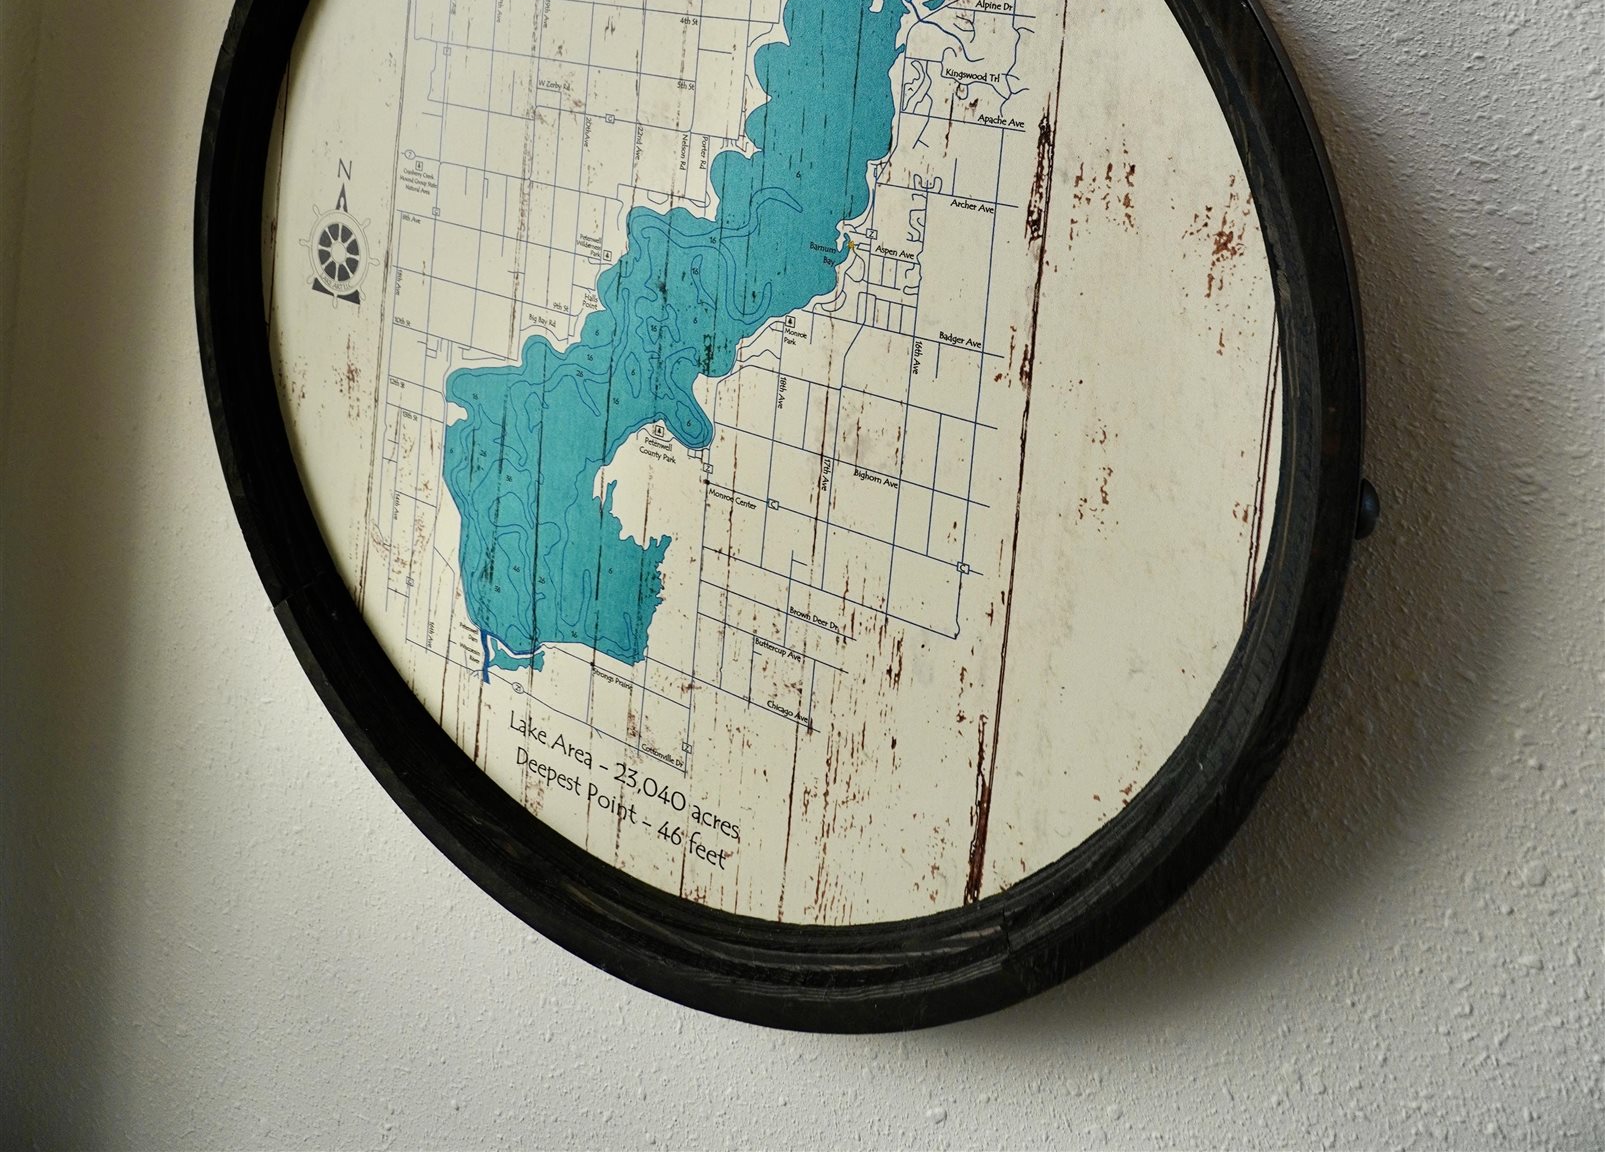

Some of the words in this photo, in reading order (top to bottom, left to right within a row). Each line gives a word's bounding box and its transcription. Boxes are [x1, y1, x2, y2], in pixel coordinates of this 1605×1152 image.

[976, 0, 1002, 11] Alpine
[1003, 3, 1013, 11] Dr
[946, 68, 987, 82] Kingswood
[978, 114, 1006, 126] Apache
[1008, 118, 1024, 128] Ave
[680, 134, 688, 159] Nelson
[700, 136, 708, 158] Porter
[338, 158, 352, 180] N
[679, 160, 686, 170] Rd
[700, 160, 706, 170] Rd
[950, 200, 977, 211] Archer
[978, 203, 994, 214] Ave
[876, 245, 898, 258] Aspen
[899, 250, 914, 260] Ave
[939, 332, 964, 345] Badger
[966, 338, 982, 349] Ave
[914, 341, 923, 357] 16th
[912, 358, 922, 374] Ave
[779, 377, 787, 394] 18th
[778, 394, 786, 409] Ave
[640, 446, 662, 460] County
[663, 452, 676, 464] Park
[822, 459, 830, 475] 17th
[821, 476, 830, 491] Ave
[854, 468, 882, 485] Bighorn
[883, 477, 898, 489] Ave
[709, 488, 734, 502] Monroe
[736, 496, 758, 510] Center
[790, 606, 810, 621] Brown
[755, 638, 787, 658] Buttercup
[788, 650, 802, 663] Ave
[767, 700, 794, 717] Chicago
[794, 712, 808, 724] Ave
[641, 743, 674, 767] Cottonville
[675, 760, 684, 768] Dr
[510, 710, 547, 745] Lake
[551, 734, 593, 769] Area
[614, 764, 686, 811] 23,040
[692, 805, 739, 840] acres
[516, 746, 582, 796] Deepest
[588, 782, 637, 825] Point
[658, 821, 682, 846] 46
[689, 832, 726, 870] feet
